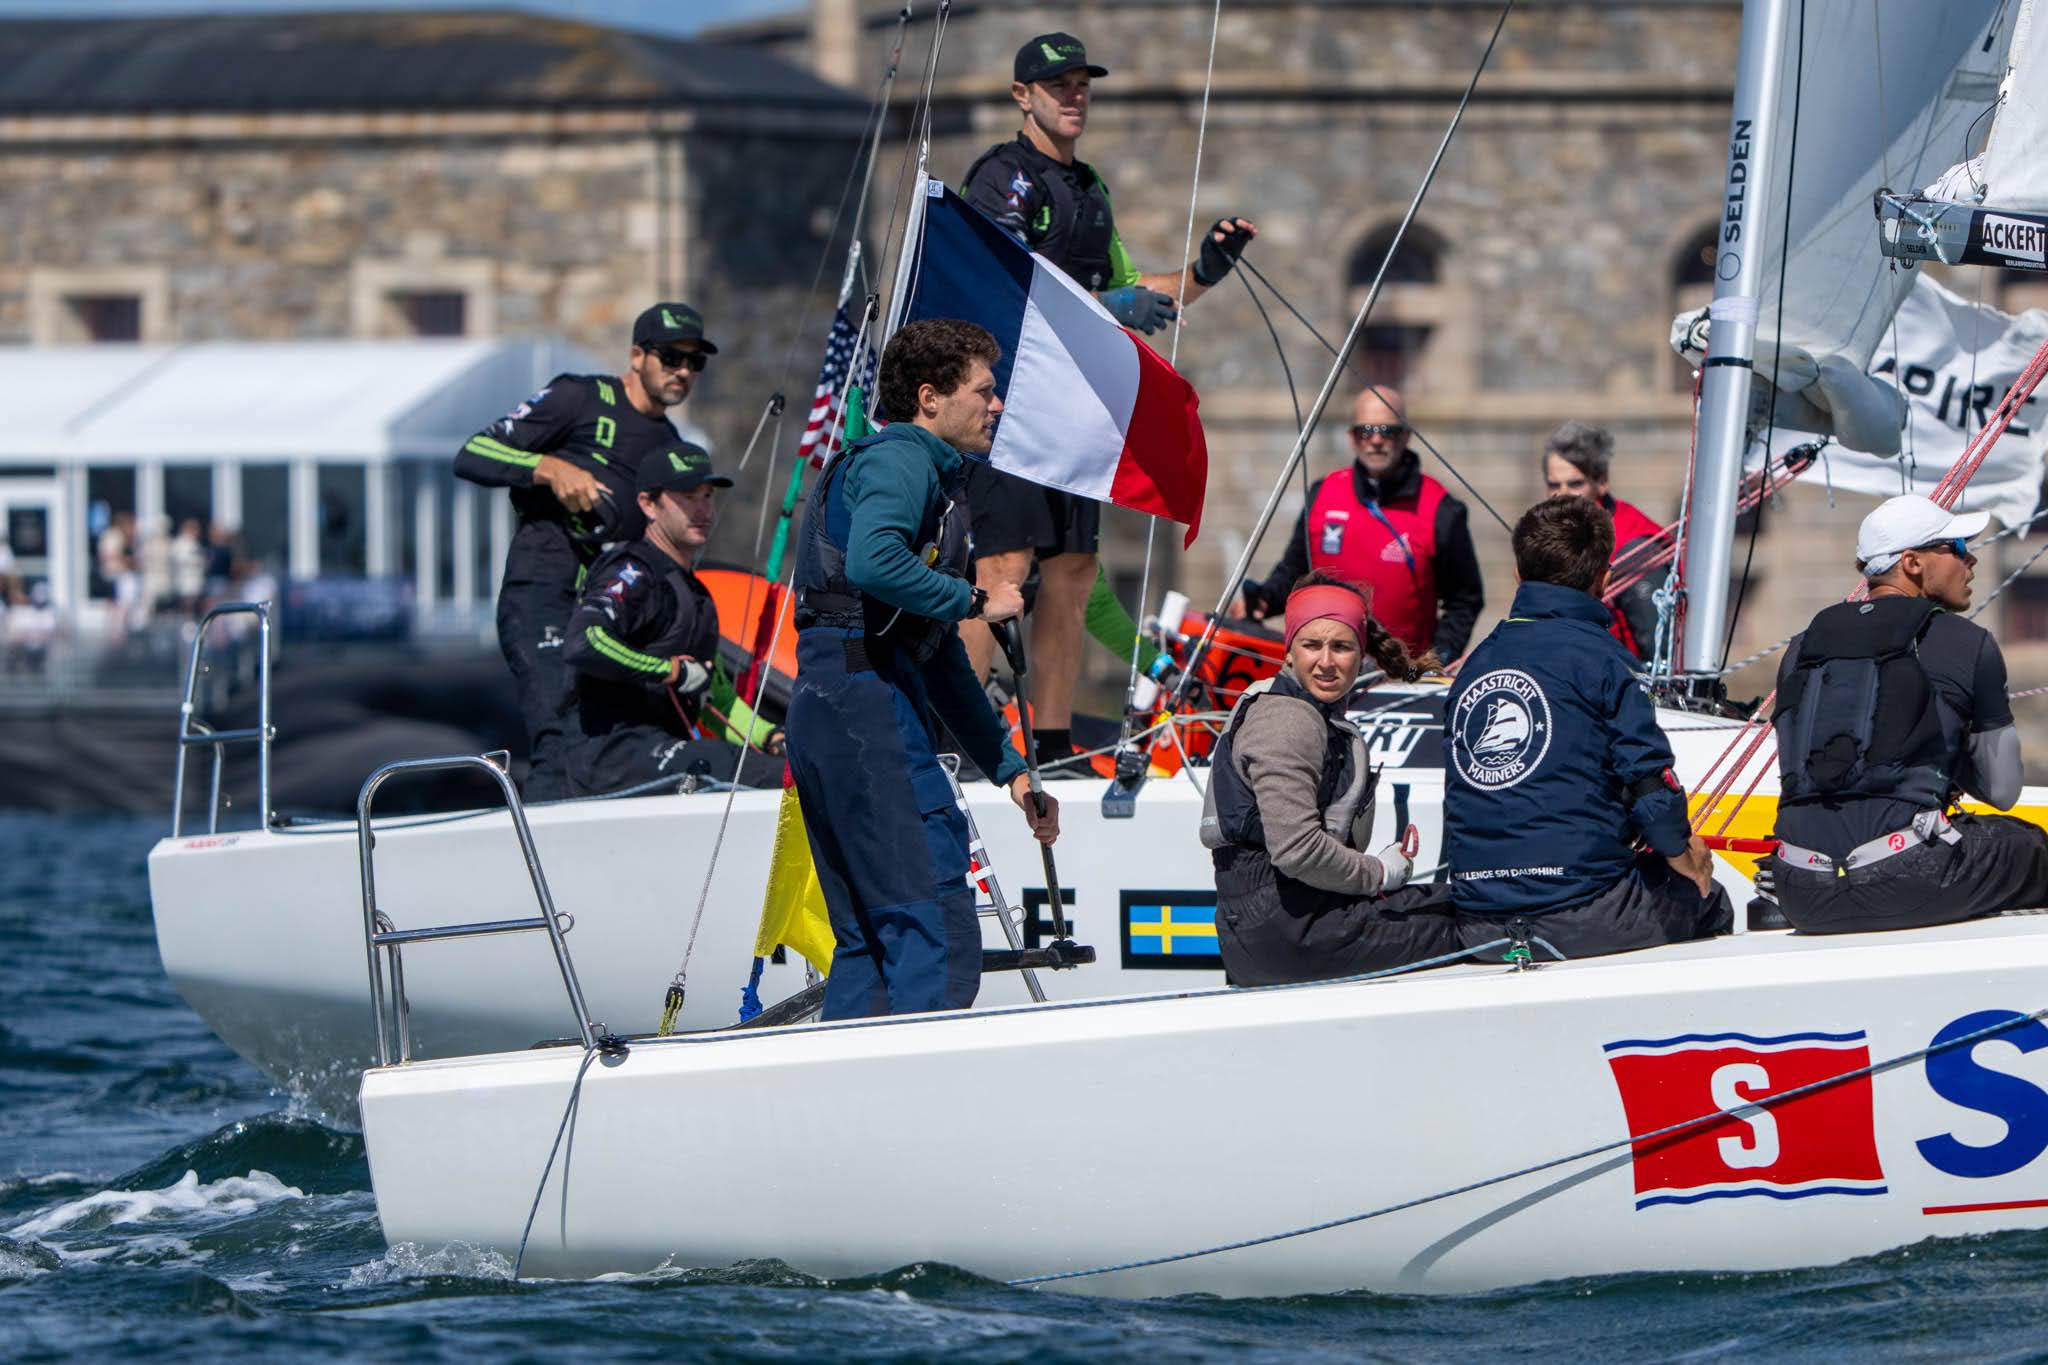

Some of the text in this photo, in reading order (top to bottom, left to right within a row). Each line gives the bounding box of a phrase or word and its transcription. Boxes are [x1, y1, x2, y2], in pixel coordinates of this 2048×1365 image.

[1983, 222, 2046, 252] ACKERT
[1461, 675, 1537, 712] MAASTRICHT
[1467, 760, 1526, 783] MARINERS
[1495, 869, 1510, 878] SPI
[1511, 867, 1564, 878] DAUPHINE
[1915, 1009, 2048, 1178] S
[1710, 1063, 1780, 1170] S
